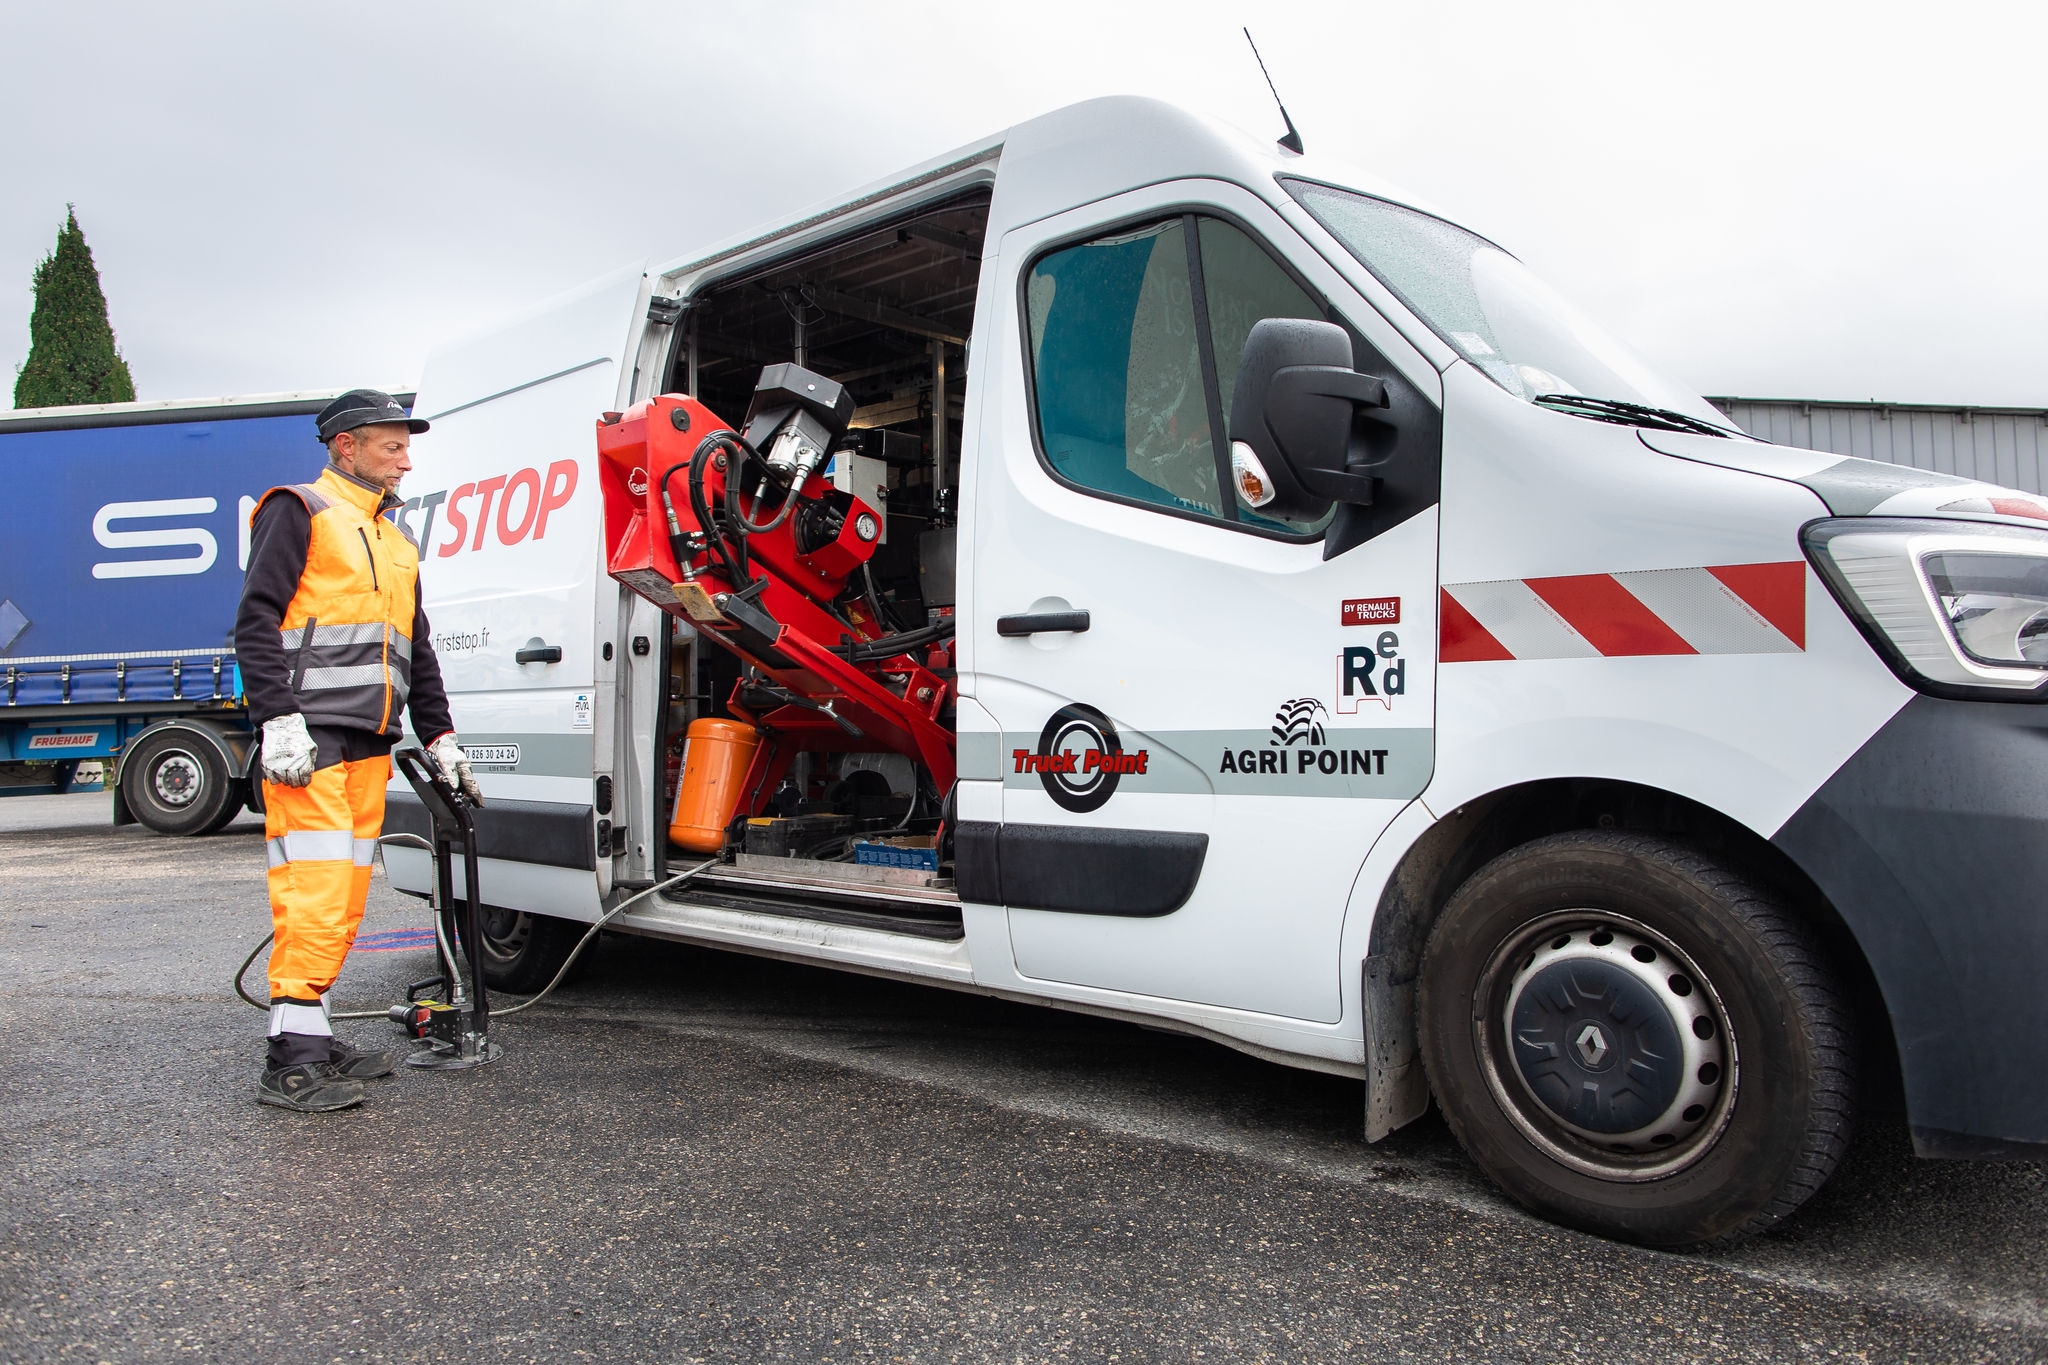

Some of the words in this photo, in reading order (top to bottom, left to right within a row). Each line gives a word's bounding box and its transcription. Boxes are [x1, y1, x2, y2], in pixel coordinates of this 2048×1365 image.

[397, 459, 579, 562] STSTOP
[1344, 604, 1355, 613] BY
[1357, 602, 1396, 612] RENAULT
[1357, 610, 1396, 619] TRUCKS
[431, 626, 490, 654] firststop.fr
[34, 735, 93, 747] FRUEHAUF
[465, 749, 470, 759] 0
[472, 749, 484, 759] 826
[486, 749, 494, 759] 30
[496, 749, 504, 759] 24
[506, 749, 515, 759] 24
[1012, 749, 1080, 774] Truck
[1082, 749, 1149, 774] Point
[1298, 750, 1389, 775] POINT
